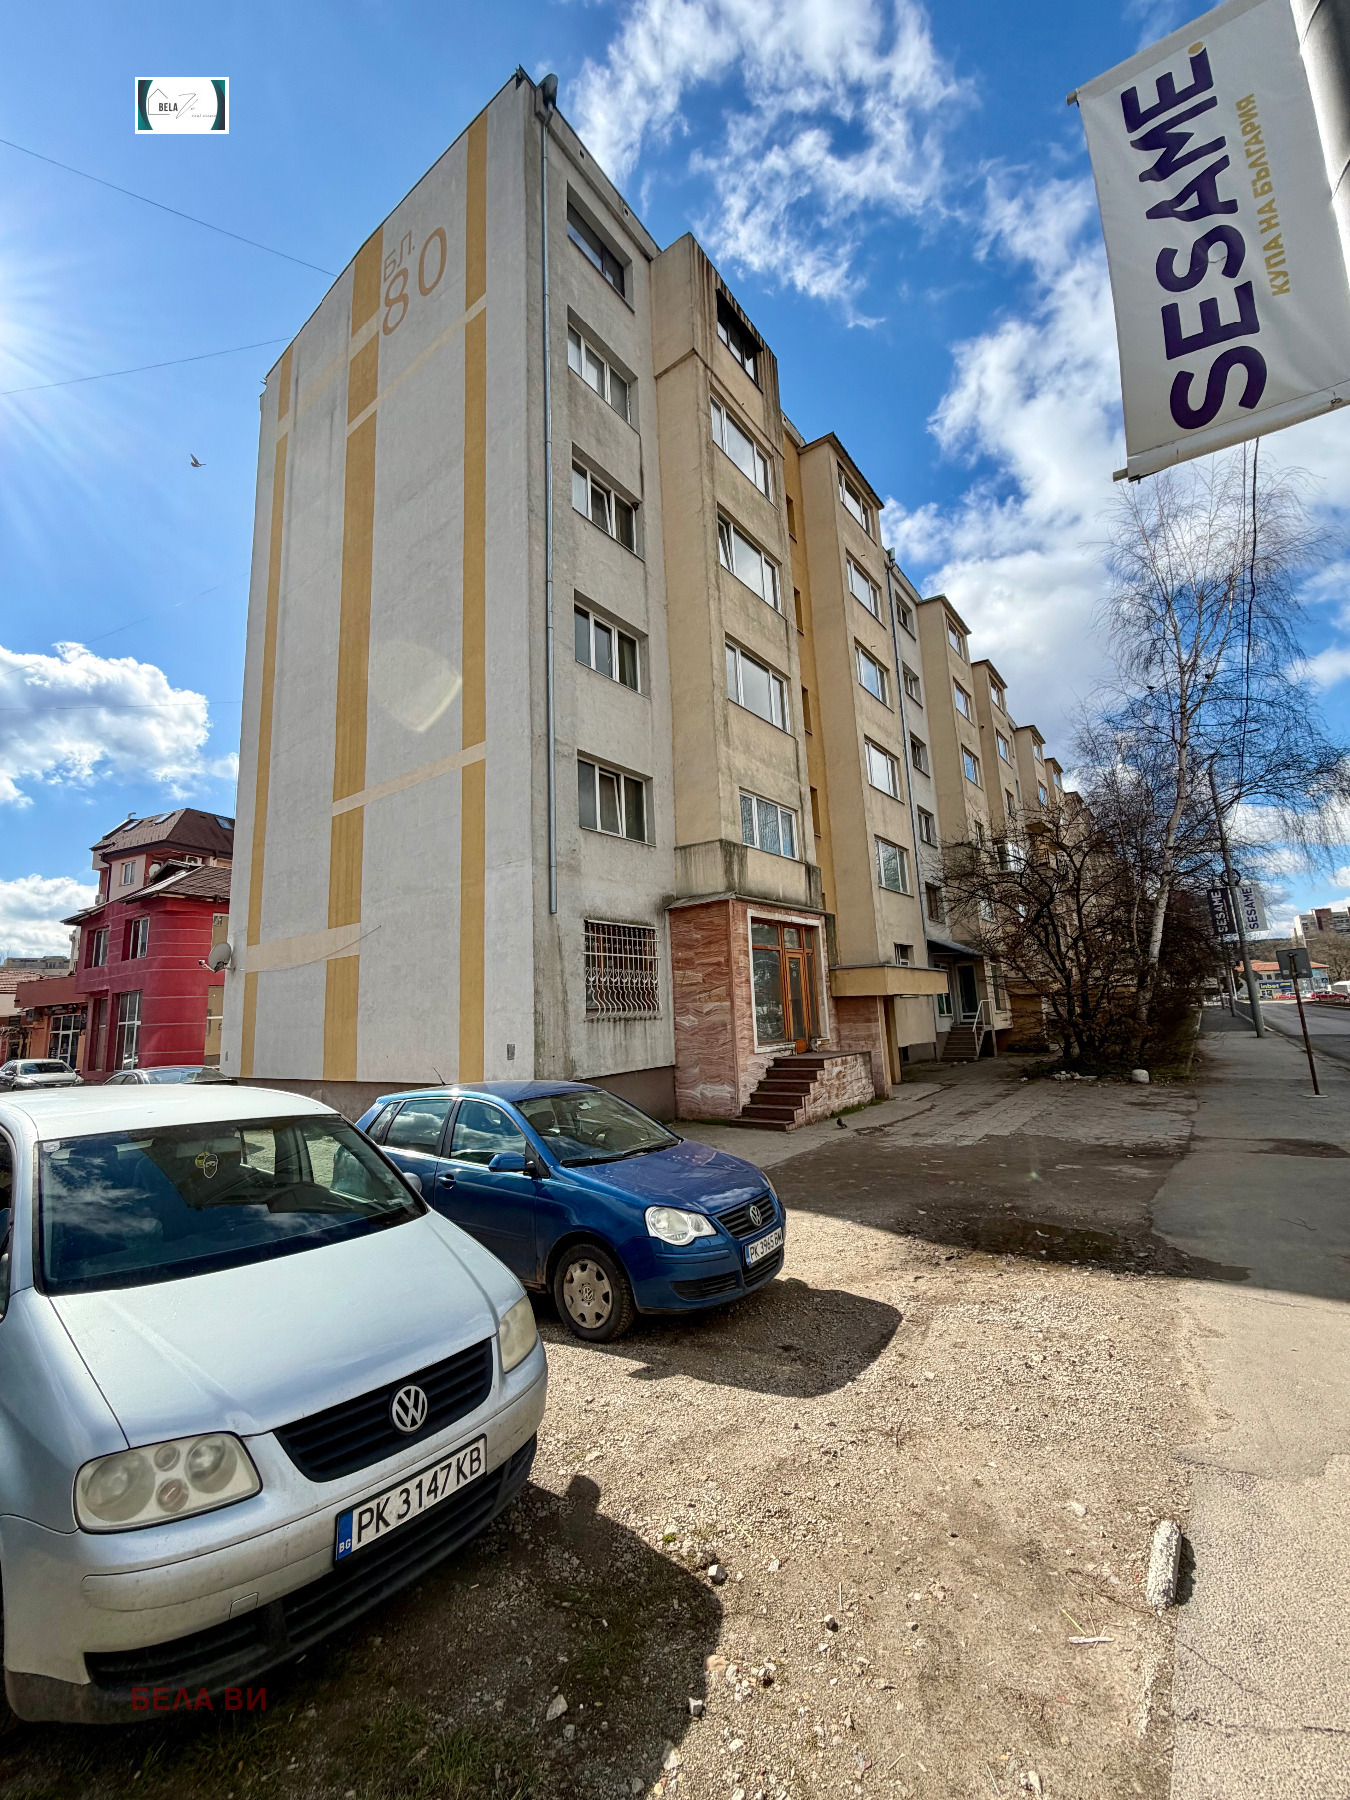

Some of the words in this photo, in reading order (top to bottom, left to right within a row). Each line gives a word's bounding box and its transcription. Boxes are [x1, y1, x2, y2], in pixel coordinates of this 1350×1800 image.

[1236, 94, 1274, 199] БЪЛГАРИЯ
[1257, 198, 1280, 234] НА
[383, 229, 415, 283] БЛ.
[1263, 233, 1290, 297] КУПА
[383, 226, 447, 336] 80
[1210, 889, 1229, 933] SESAME
[1241, 886, 1260, 930] SESAME
[749, 1243, 760, 1261] PK
[392, 1385, 428, 1432] VW
[357, 1496, 391, 1544] PK
[397, 1461, 452, 1520] 3147
[456, 1446, 482, 1486] KB
[338, 1538, 352, 1553] BG
